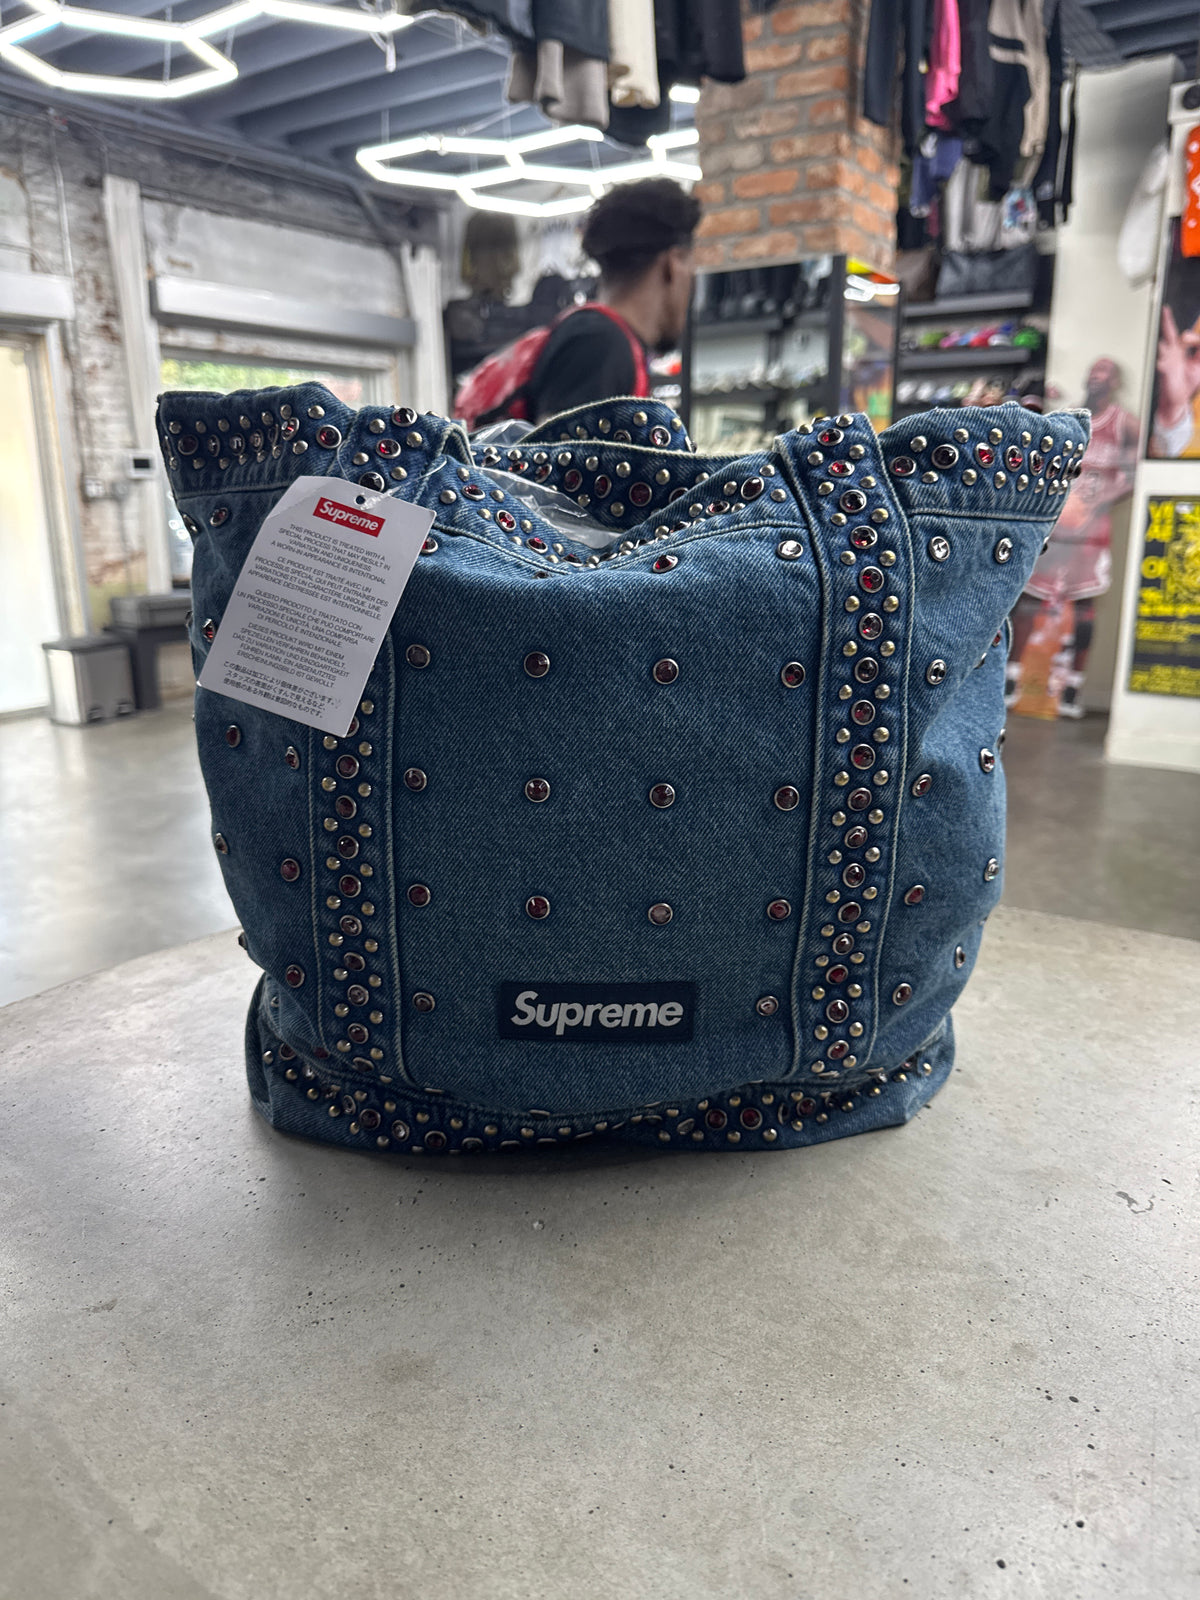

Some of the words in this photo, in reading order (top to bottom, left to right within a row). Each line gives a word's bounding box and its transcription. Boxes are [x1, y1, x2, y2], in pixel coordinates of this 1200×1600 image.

[319, 500, 379, 531] Supreme
[275, 541, 303, 555] WORN-IN
[302, 550, 340, 568] APPEARANCE
[278, 527, 302, 540] SPECIAL
[303, 535, 331, 550] PROCESS
[331, 545, 346, 555] THAT
[347, 551, 360, 560] MAY
[360, 555, 382, 568] RESULT
[288, 538, 319, 553] VARIATION
[319, 549, 333, 558] AND
[289, 523, 303, 532] THIS
[303, 528, 331, 542] PRODUCT
[338, 540, 364, 554] TREATED
[364, 549, 381, 560] WITH
[247, 568, 282, 585] APPARENCE
[320, 593, 332, 602] EST
[254, 555, 290, 572] PROCESSUS
[314, 576, 326, 585] QUI
[326, 580, 343, 591] PEUT
[375, 597, 389, 607] DES
[254, 562, 289, 580] VARIATIONS
[368, 602, 382, 612] UNE
[286, 558, 312, 572] PRODUIT
[312, 568, 324, 577] EST
[345, 579, 362, 590] AVEC
[246, 593, 278, 609] PROCESSO
[278, 604, 306, 619] SPECIALE
[306, 614, 319, 623] CHE
[334, 624, 375, 643] COMPORTARE
[247, 601, 280, 618] VARIAZIONI
[311, 624, 325, 633] UNA
[254, 588, 279, 602] QUESTO
[279, 597, 312, 613] PRODOTTO
[318, 610, 347, 625] TRATTATO
[347, 621, 362, 630] CON
[264, 615, 294, 630] PERICOLO
[232, 632, 245, 641] DAS
[254, 640, 286, 655] VARIATION
[285, 650, 300, 660] UND
[300, 656, 349, 677] EINZIGARTIGKEIT
[239, 627, 272, 642] SPEZIELLEN
[271, 638, 310, 656] VERFAHREN
[247, 622, 269, 633] DIESES
[269, 629, 298, 643] PRODUKT
[297, 639, 314, 649] WIRD
[325, 649, 344, 660] EINEM
[236, 649, 295, 674] ERSCHEINUNGSBILD
[293, 661, 336, 681] ABGENUTZTES
[510, 990, 684, 1036] Supreme
